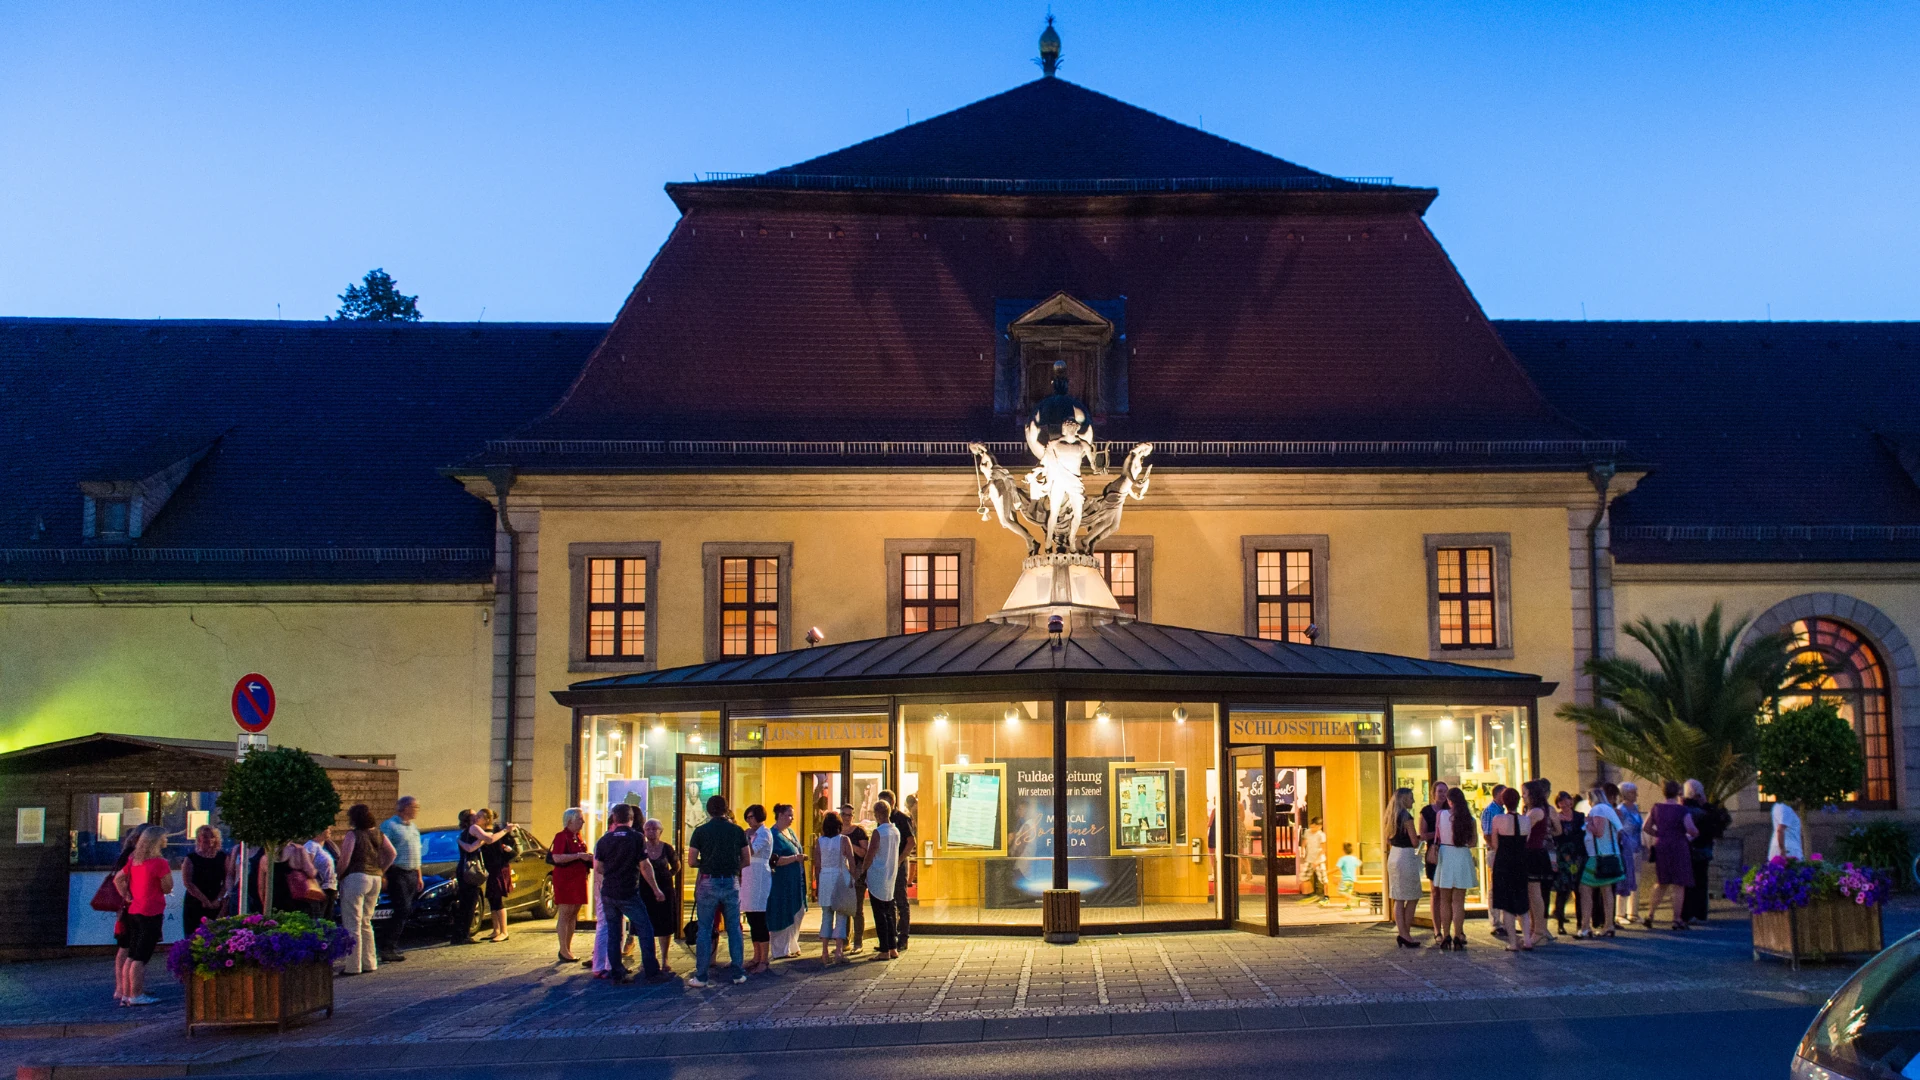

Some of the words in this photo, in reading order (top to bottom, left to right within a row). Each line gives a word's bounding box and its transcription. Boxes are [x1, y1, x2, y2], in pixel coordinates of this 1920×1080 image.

[1234, 720, 1381, 736] SCHLOSSTHEATER
[1017, 770, 1054, 783] Fuldae
[1066, 770, 1102, 785] eitung
[1017, 787, 1029, 796] Wir
[1030, 787, 1051, 796] setzen
[1074, 787, 1080, 796] in
[1081, 786, 1102, 796] Szene!
[1046, 814, 1086, 823] MICAL
[1046, 838, 1086, 847] FDA
